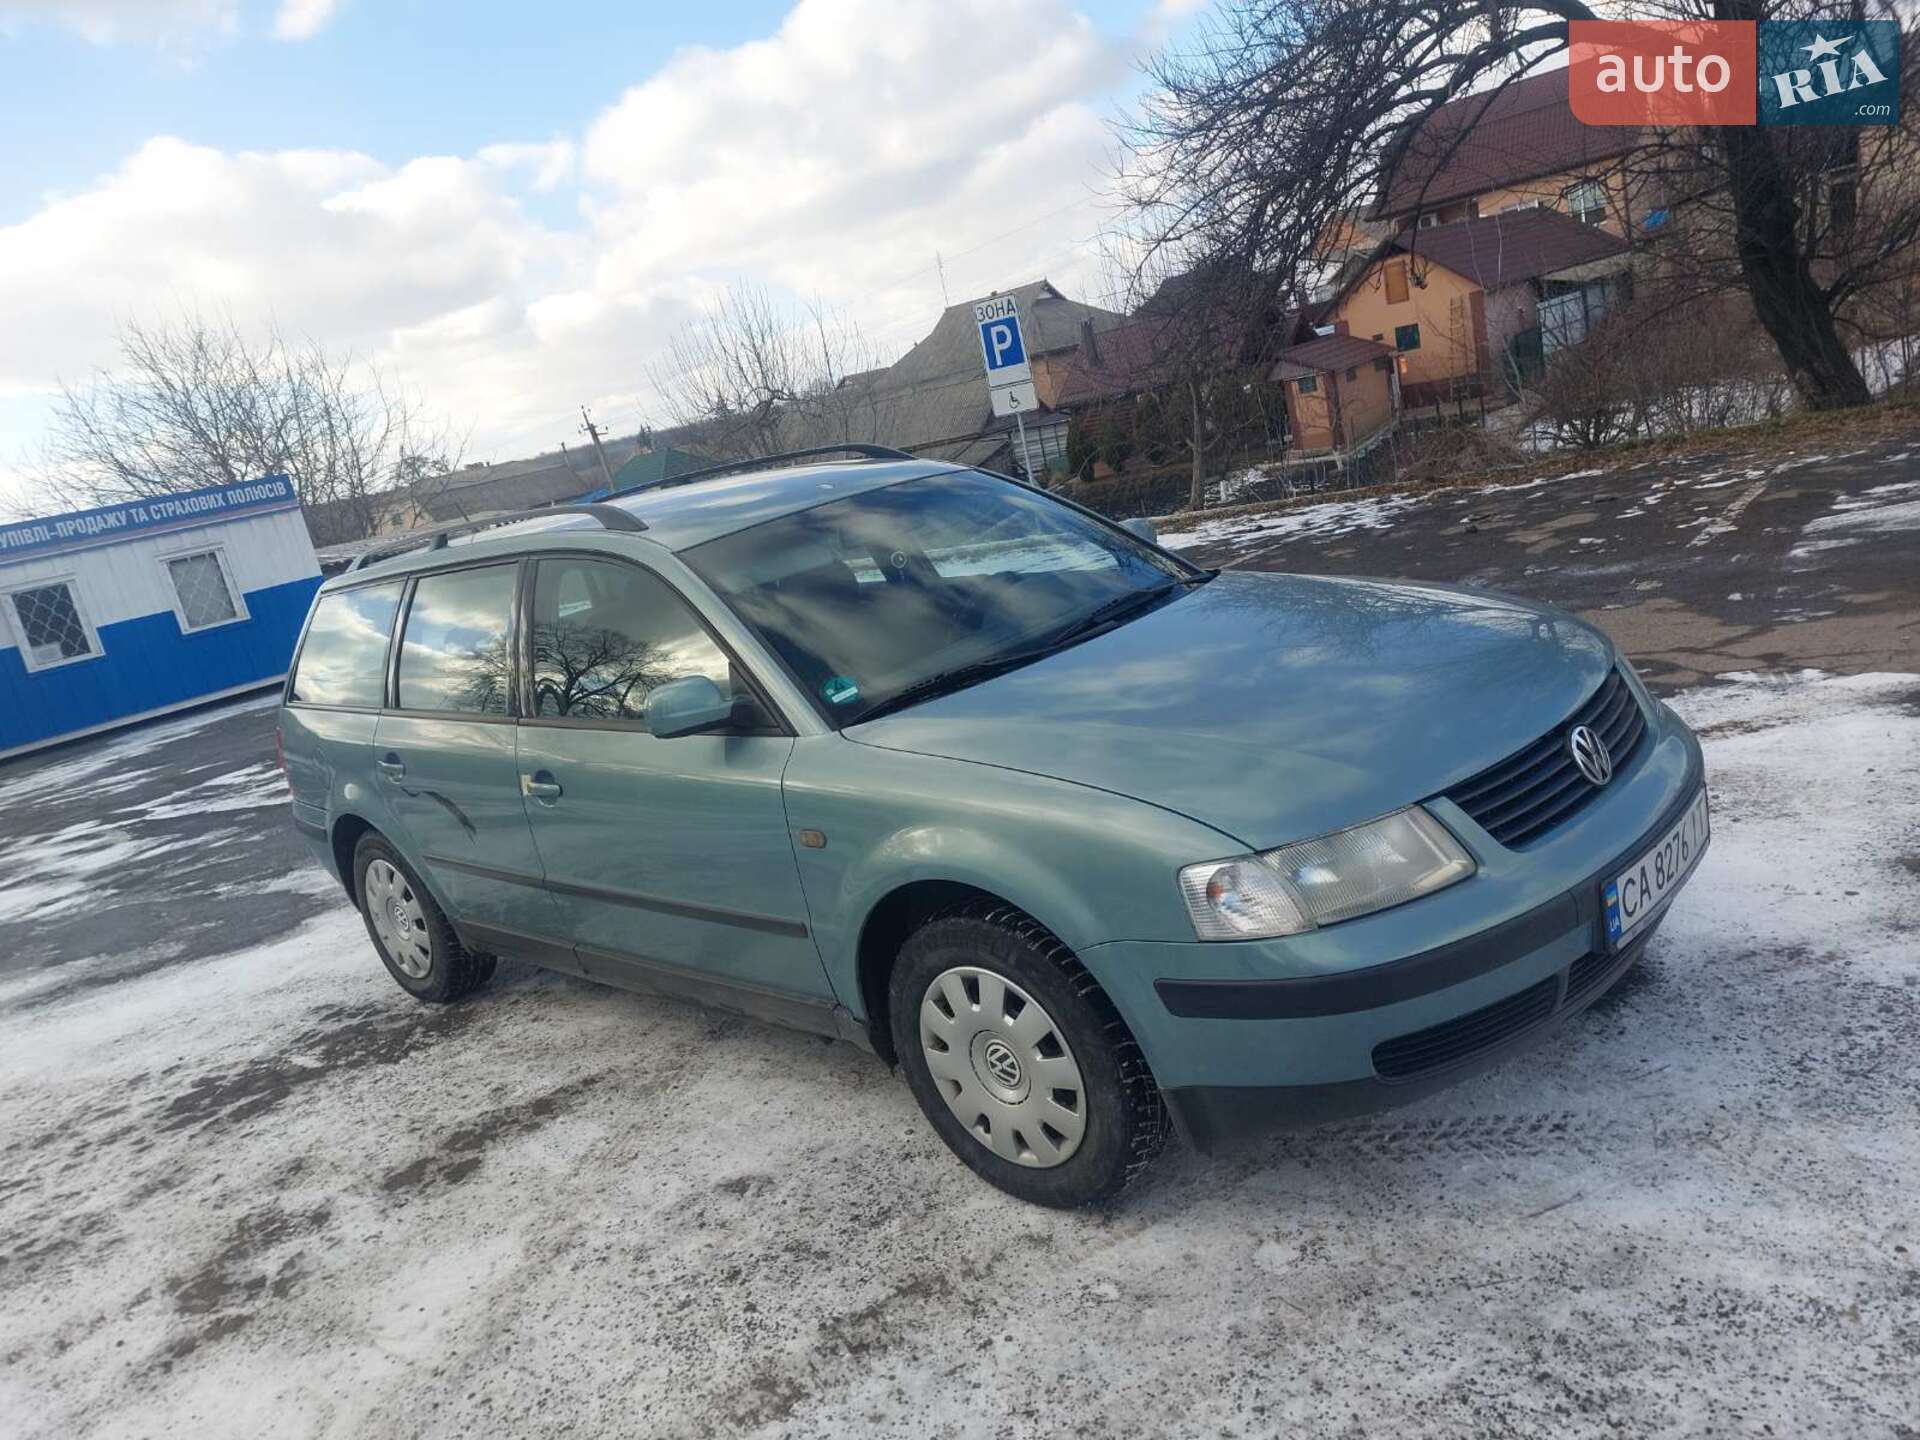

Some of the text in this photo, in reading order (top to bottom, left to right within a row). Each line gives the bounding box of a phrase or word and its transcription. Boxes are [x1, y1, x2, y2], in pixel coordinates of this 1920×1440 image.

[976, 298, 1016, 322] ЗОНА
[990, 324, 1012, 366] P
[131, 508, 149, 523] ТА
[151, 492, 226, 520] СТРАХОВИХ
[226, 481, 287, 505] ПОЛЮСІВ
[1622, 865, 1652, 918] CA
[1655, 821, 1689, 890] 8276
